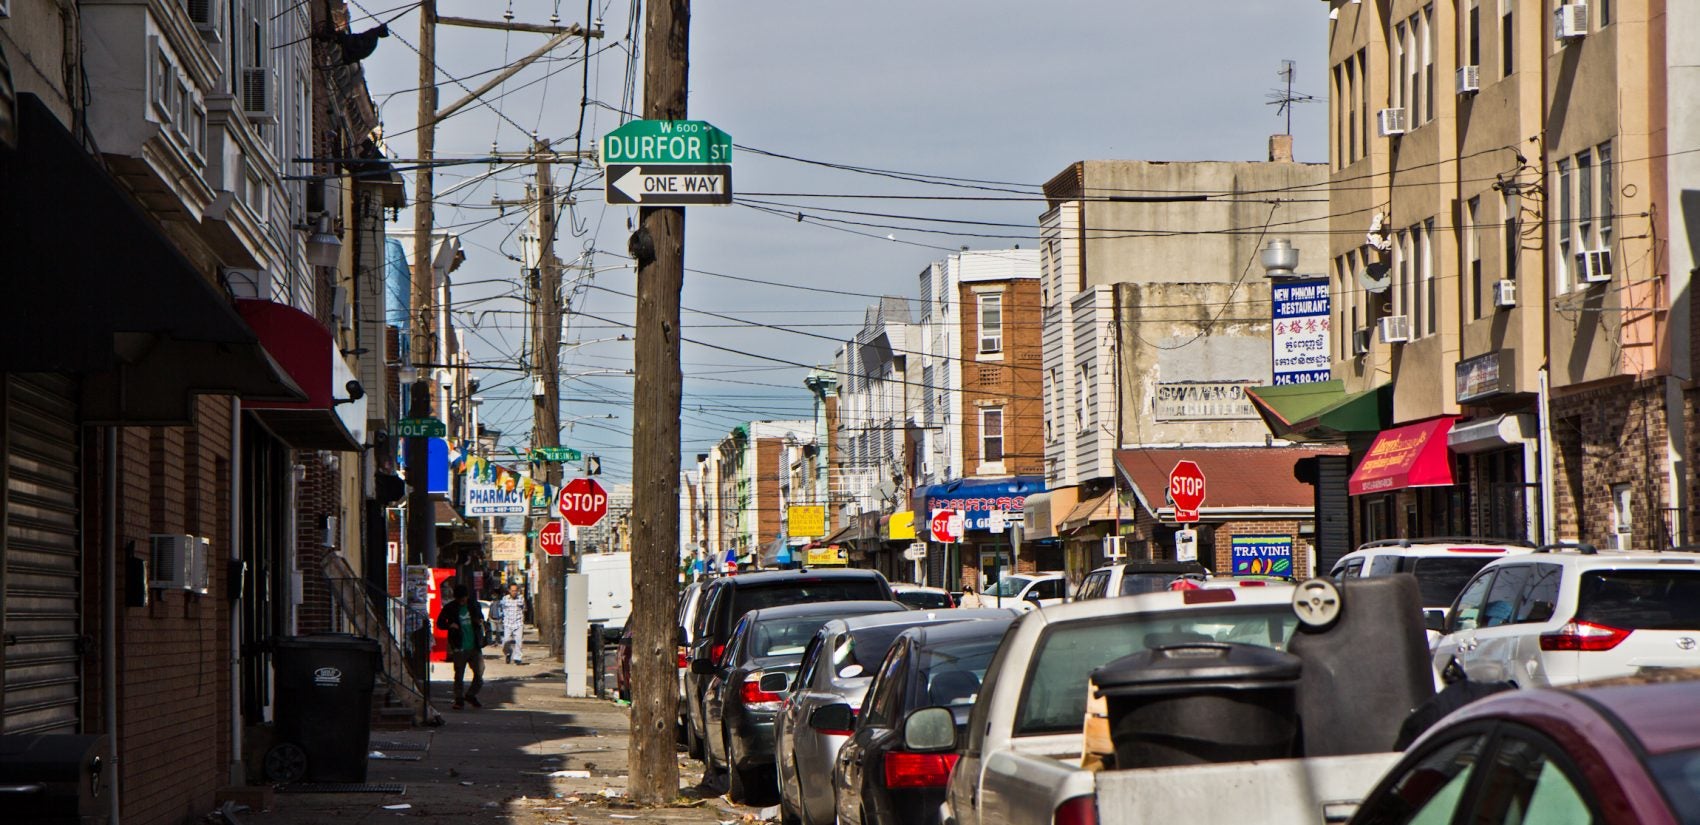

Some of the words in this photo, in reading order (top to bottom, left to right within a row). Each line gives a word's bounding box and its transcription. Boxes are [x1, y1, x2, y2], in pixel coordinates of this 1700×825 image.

[660, 121, 672, 134] W
[676, 123, 698, 133] 600
[608, 136, 701, 160] DURFOR
[711, 144, 729, 160] ST
[644, 176, 678, 192] ONE
[684, 176, 719, 192] WAY
[1274, 288, 1290, 302] NEW
[1291, 285, 1316, 301] PHNOM
[1316, 284, 1330, 299] PEN
[1275, 371, 1330, 386] 215-389-212
[396, 424, 429, 436] WOLF
[434, 427, 445, 436] ST
[1172, 475, 1203, 497] STOP
[470, 488, 525, 504] PHARMACY
[561, 492, 605, 512] STOP
[542, 532, 564, 545] STO
[1234, 546, 1258, 557] TRA
[1259, 545, 1290, 556] VINH
